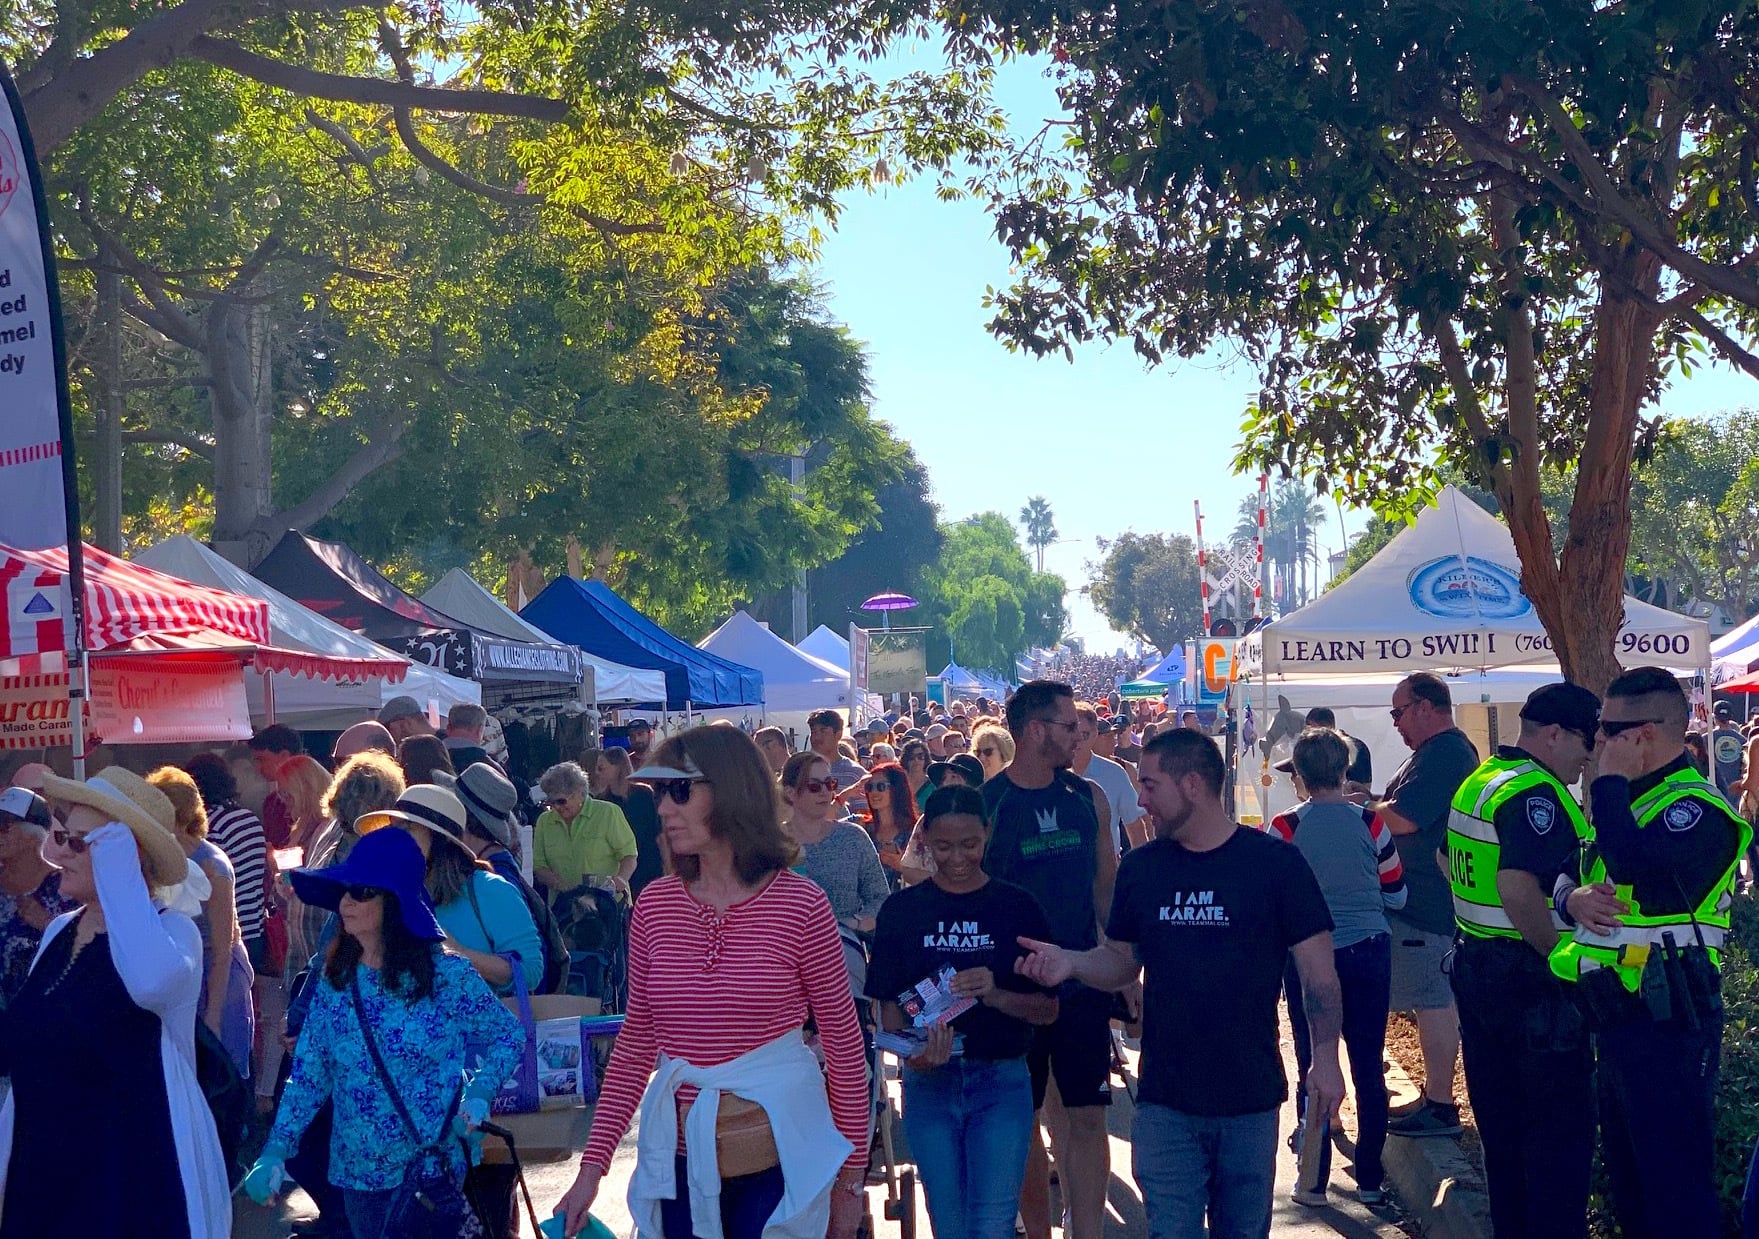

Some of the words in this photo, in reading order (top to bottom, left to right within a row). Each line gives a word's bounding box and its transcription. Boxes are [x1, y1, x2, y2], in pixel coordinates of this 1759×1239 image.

[0, 294, 27, 316] ed
[1281, 640, 1366, 662] LEARN
[1375, 638, 1412, 660] TO
[3, 722, 36, 733] Made
[1530, 800, 1553, 810] POLICE
[1175, 891, 1181, 906] I
[1185, 890, 1214, 905] AM
[1159, 905, 1230, 922] KARATE.
[938, 921, 944, 933] I
[949, 921, 978, 934] AM
[923, 934, 995, 948] KARATE.
